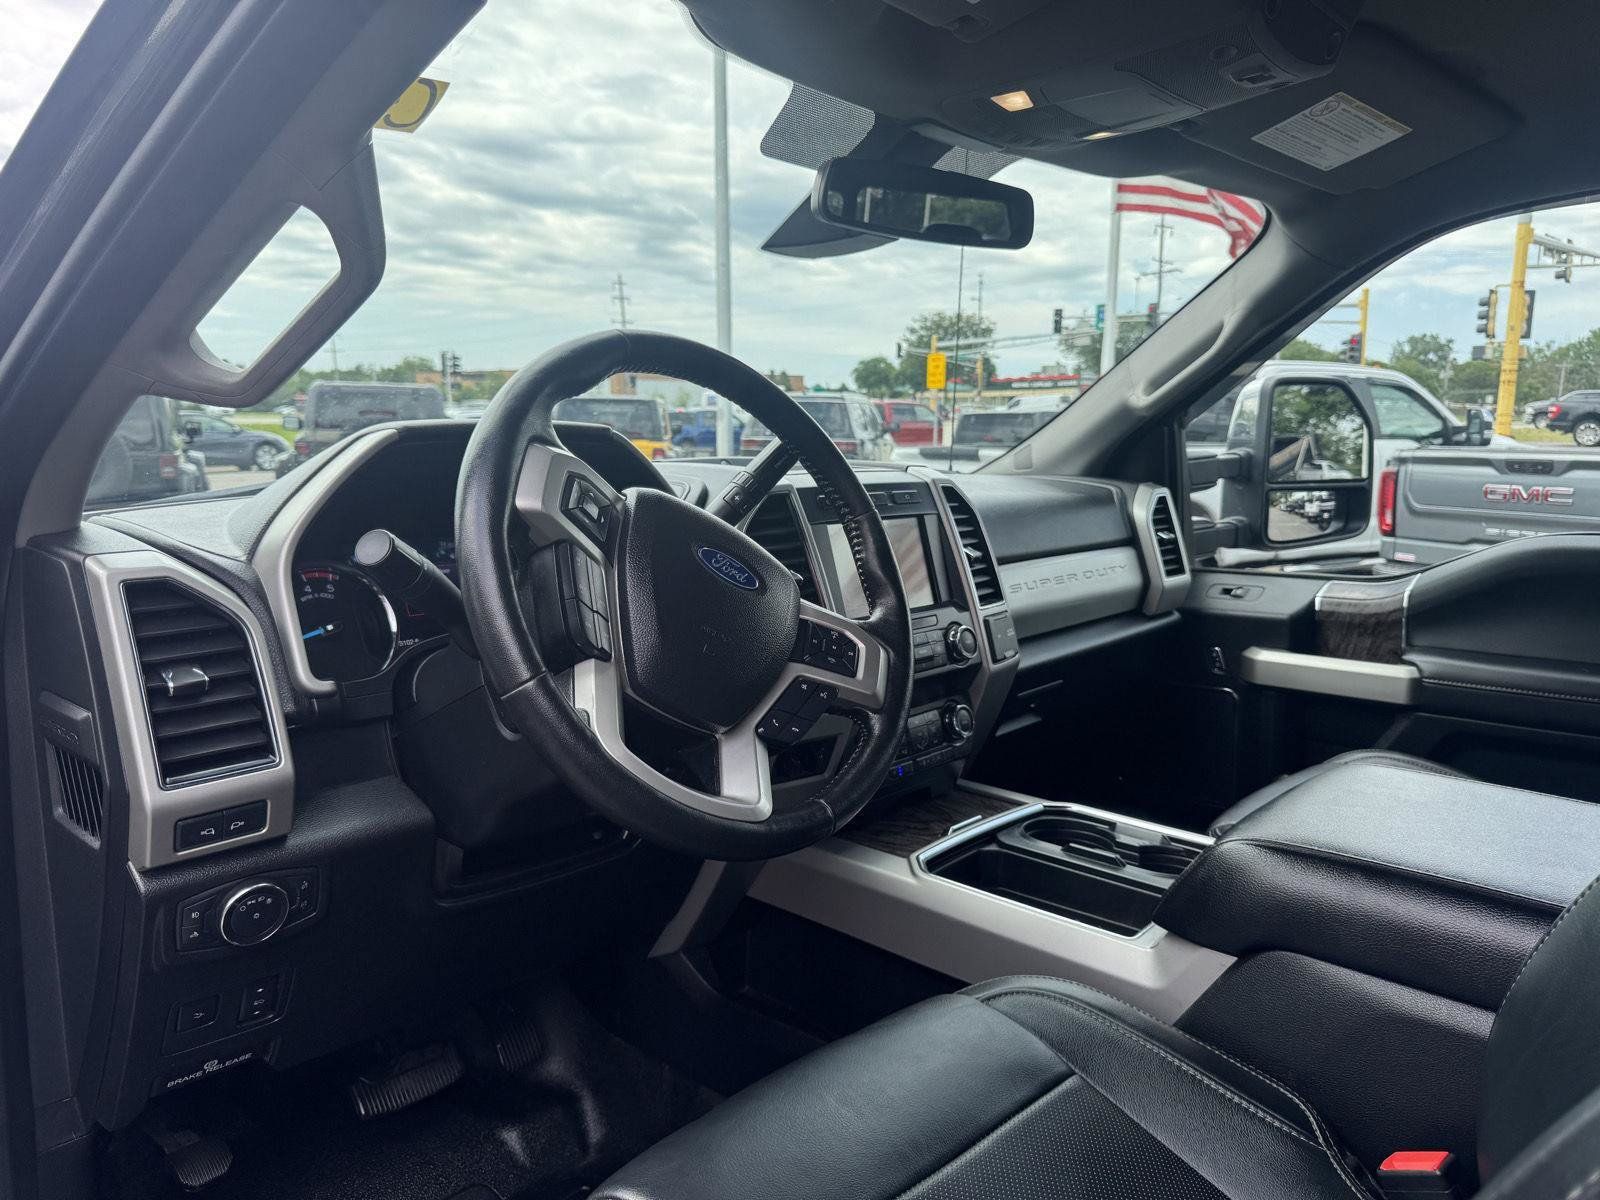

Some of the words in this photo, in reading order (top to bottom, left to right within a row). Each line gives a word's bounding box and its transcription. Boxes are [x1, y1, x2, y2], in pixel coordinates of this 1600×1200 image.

[1482, 484, 1574, 505] GMC
[711, 553, 749, 583] Ford
[1009, 573, 1079, 594] SUPER
[1082, 564, 1128, 580] DUTY
[326, 584, 335, 593] 5
[167, 1070, 204, 1088] BRAKE
[205, 1052, 254, 1074] RELEASE
